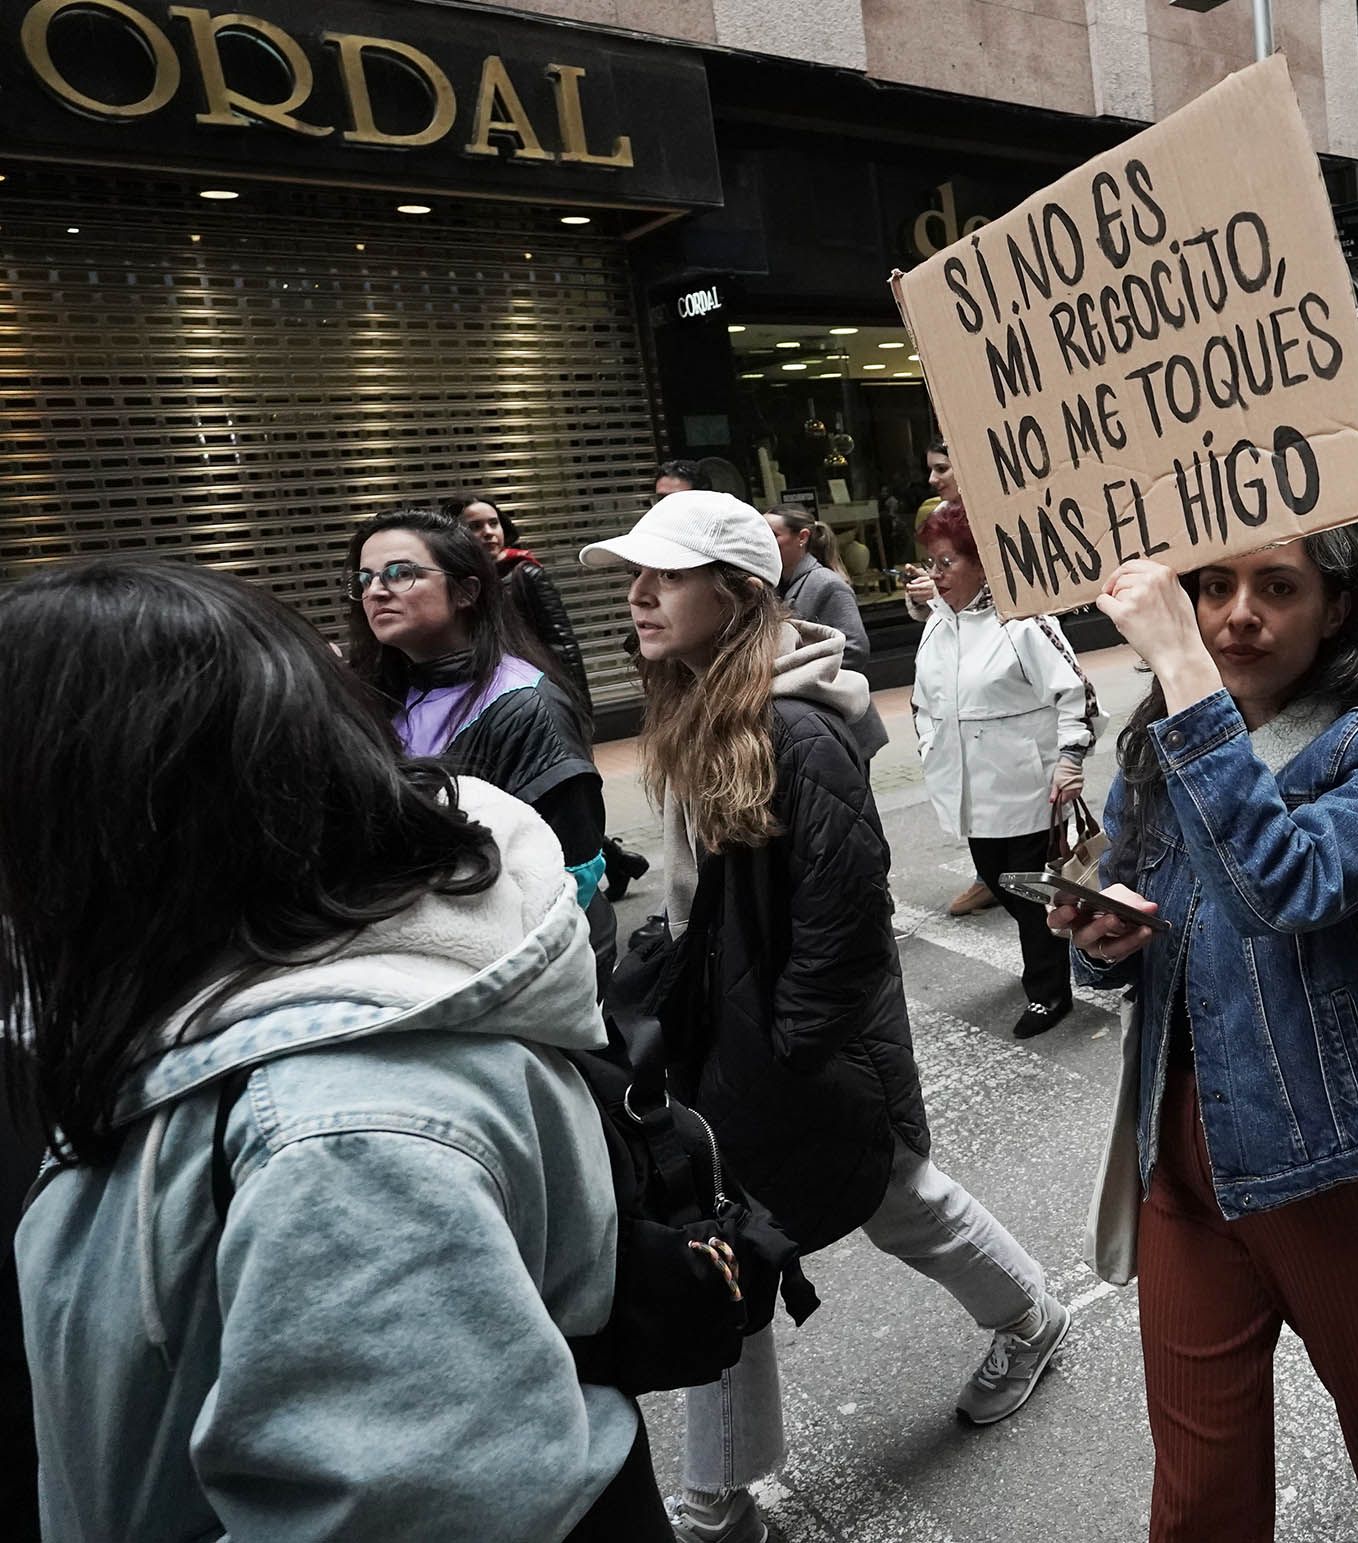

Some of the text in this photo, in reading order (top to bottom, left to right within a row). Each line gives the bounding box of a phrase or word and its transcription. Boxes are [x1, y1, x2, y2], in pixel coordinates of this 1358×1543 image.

[677, 285, 722, 318] CORDAL
[1006, 203, 1085, 311] NO
[1091, 159, 1167, 269] ES
[987, 292, 1344, 495] NO ME TOQUES
[995, 488, 1102, 606] MÁS
[1103, 478, 1170, 564] EL
